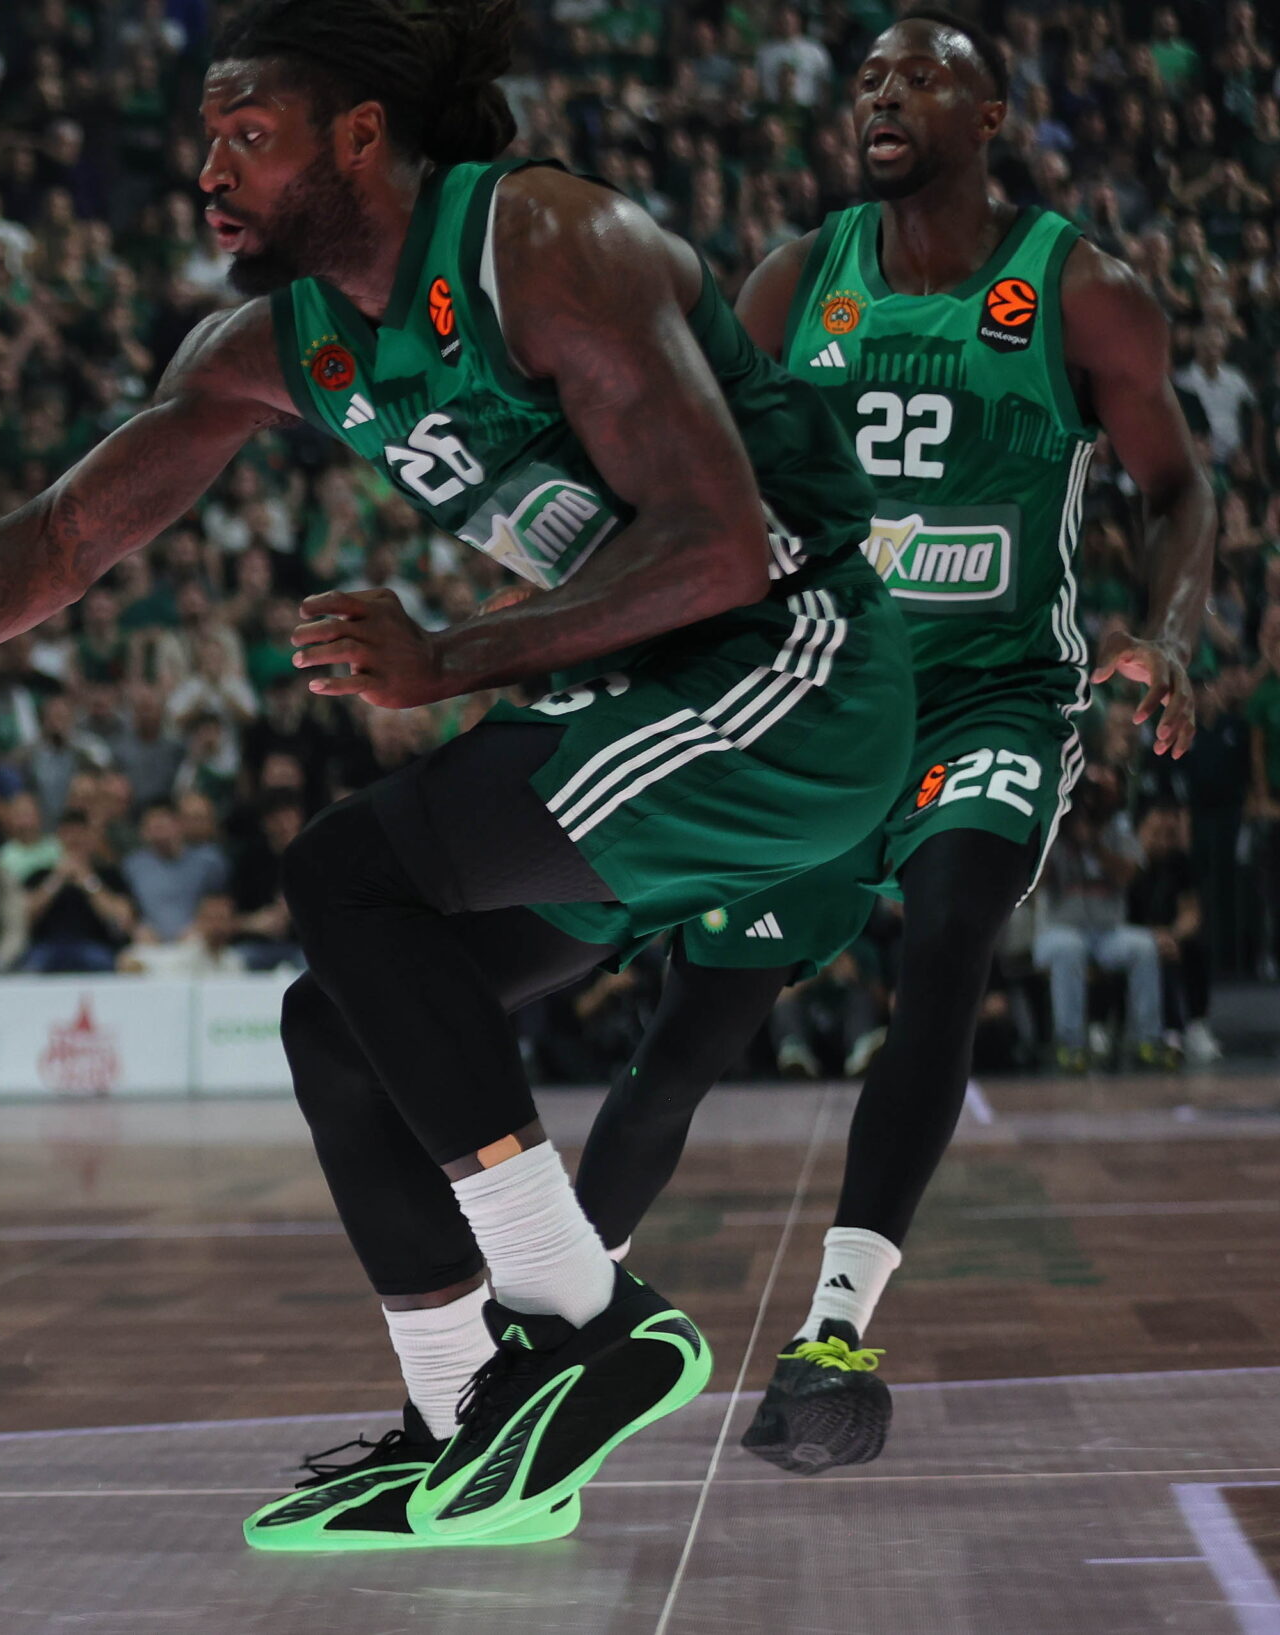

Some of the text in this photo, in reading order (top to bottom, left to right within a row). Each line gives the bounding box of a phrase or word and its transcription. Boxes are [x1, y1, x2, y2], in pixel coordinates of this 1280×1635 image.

[384, 412, 485, 507] 26
[856, 391, 953, 479] 22
[937, 748, 1042, 817] 22
